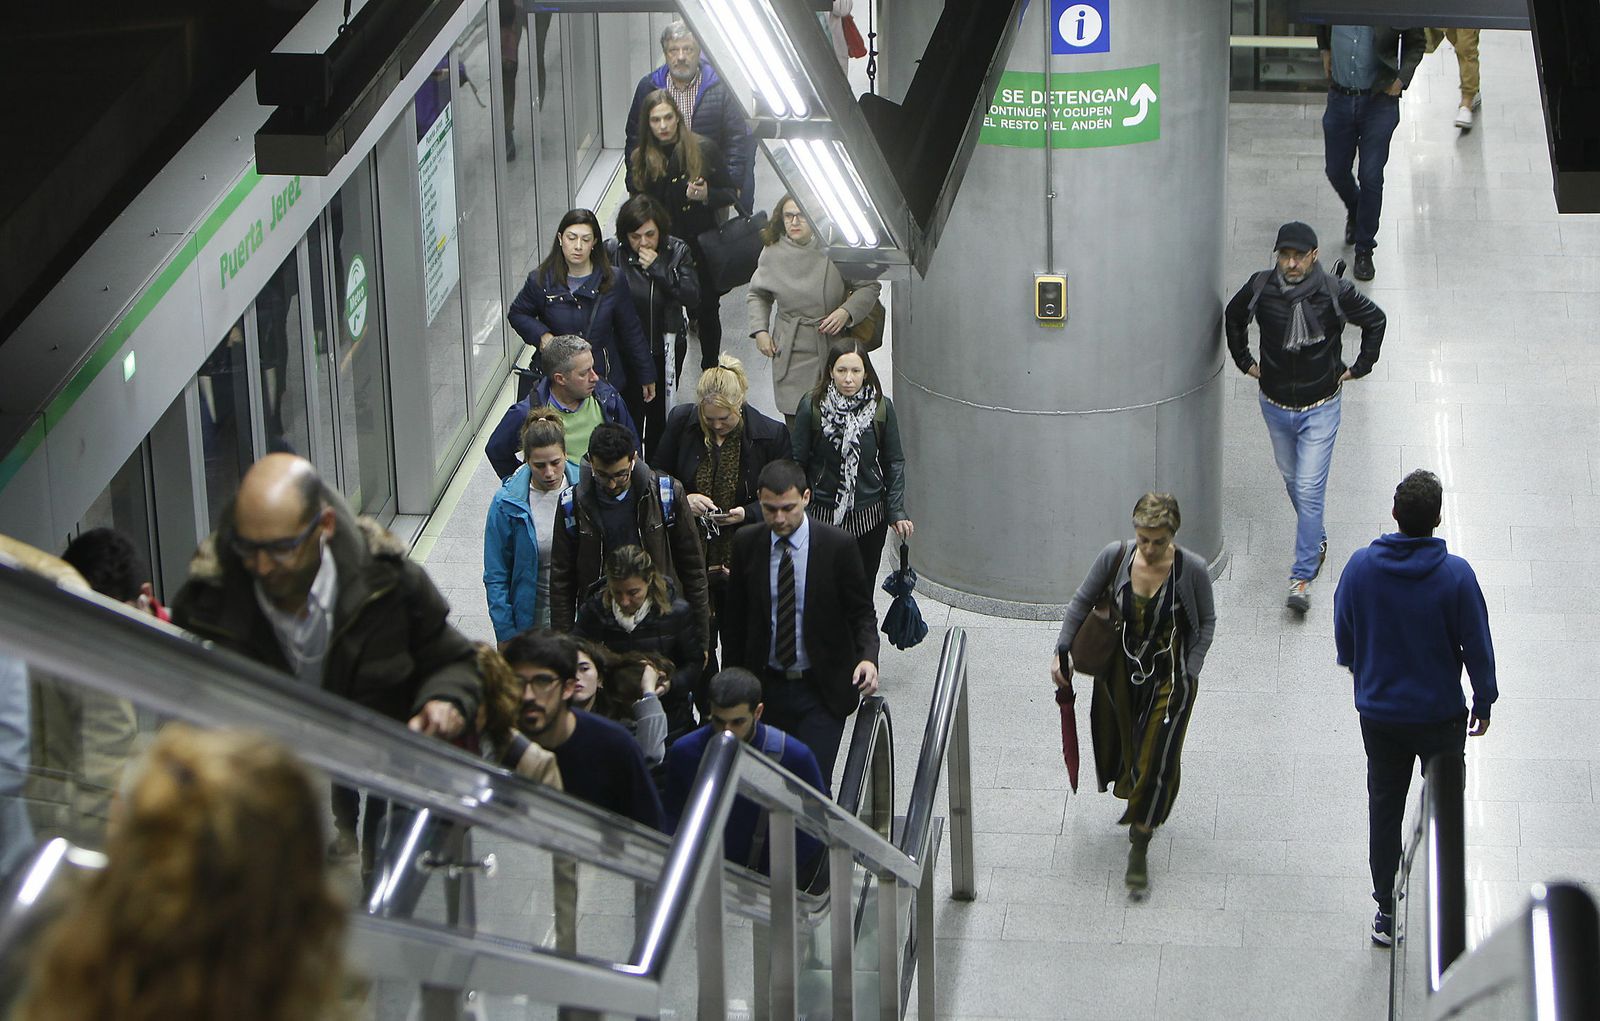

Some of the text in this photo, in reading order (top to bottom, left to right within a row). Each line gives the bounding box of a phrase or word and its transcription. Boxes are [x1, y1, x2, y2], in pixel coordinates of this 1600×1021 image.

[1002, 86, 1128, 105] SE DETENGAN
[989, 105, 1112, 118] ONTINÚEN Y OCUPEN
[983, 117, 996, 127] EL
[1001, 118, 1039, 130] RESTO
[1071, 118, 1112, 130] ANDÉN
[219, 175, 302, 290] Puerta Jerez
